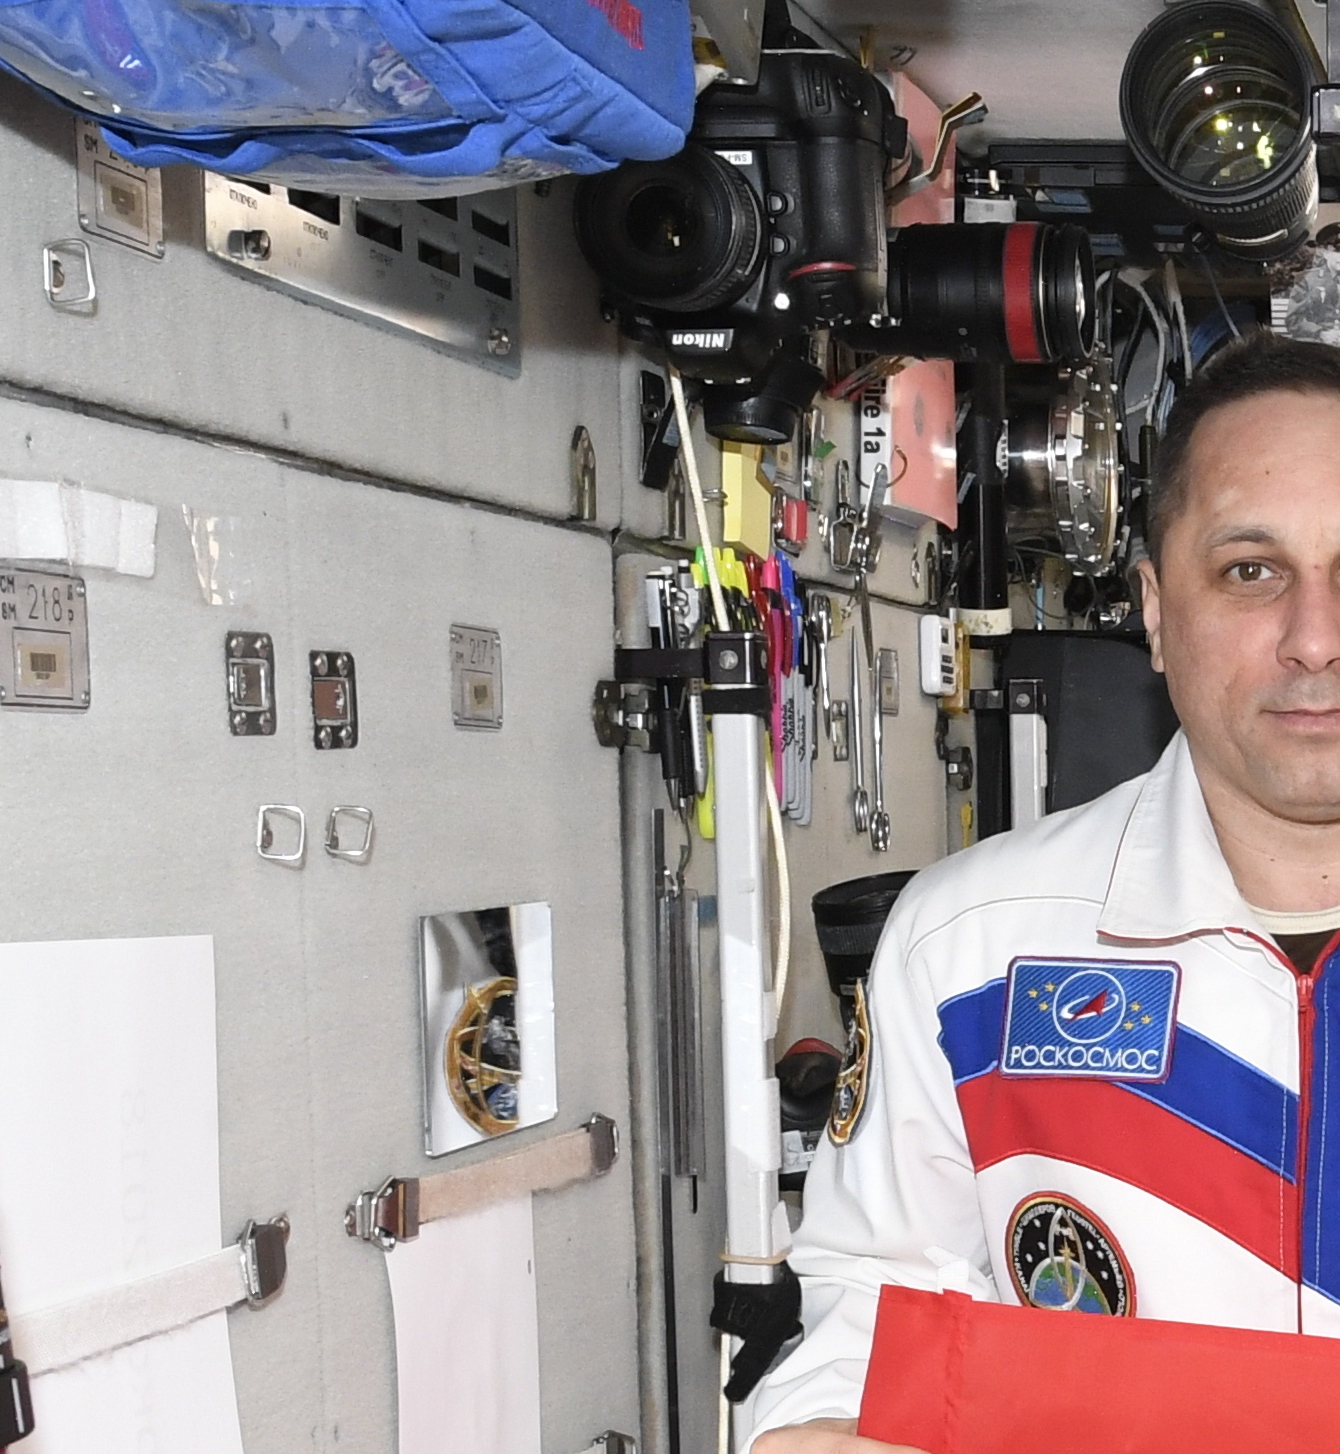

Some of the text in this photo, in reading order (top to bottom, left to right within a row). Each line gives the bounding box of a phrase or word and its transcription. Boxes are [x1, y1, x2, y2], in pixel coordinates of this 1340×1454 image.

[671, 332, 726, 349] Nikon
[862, 382, 884, 455] ire 1a
[27, 583, 63, 622] 218
[1009, 1043, 1160, 1072] РОСКОСМОС
